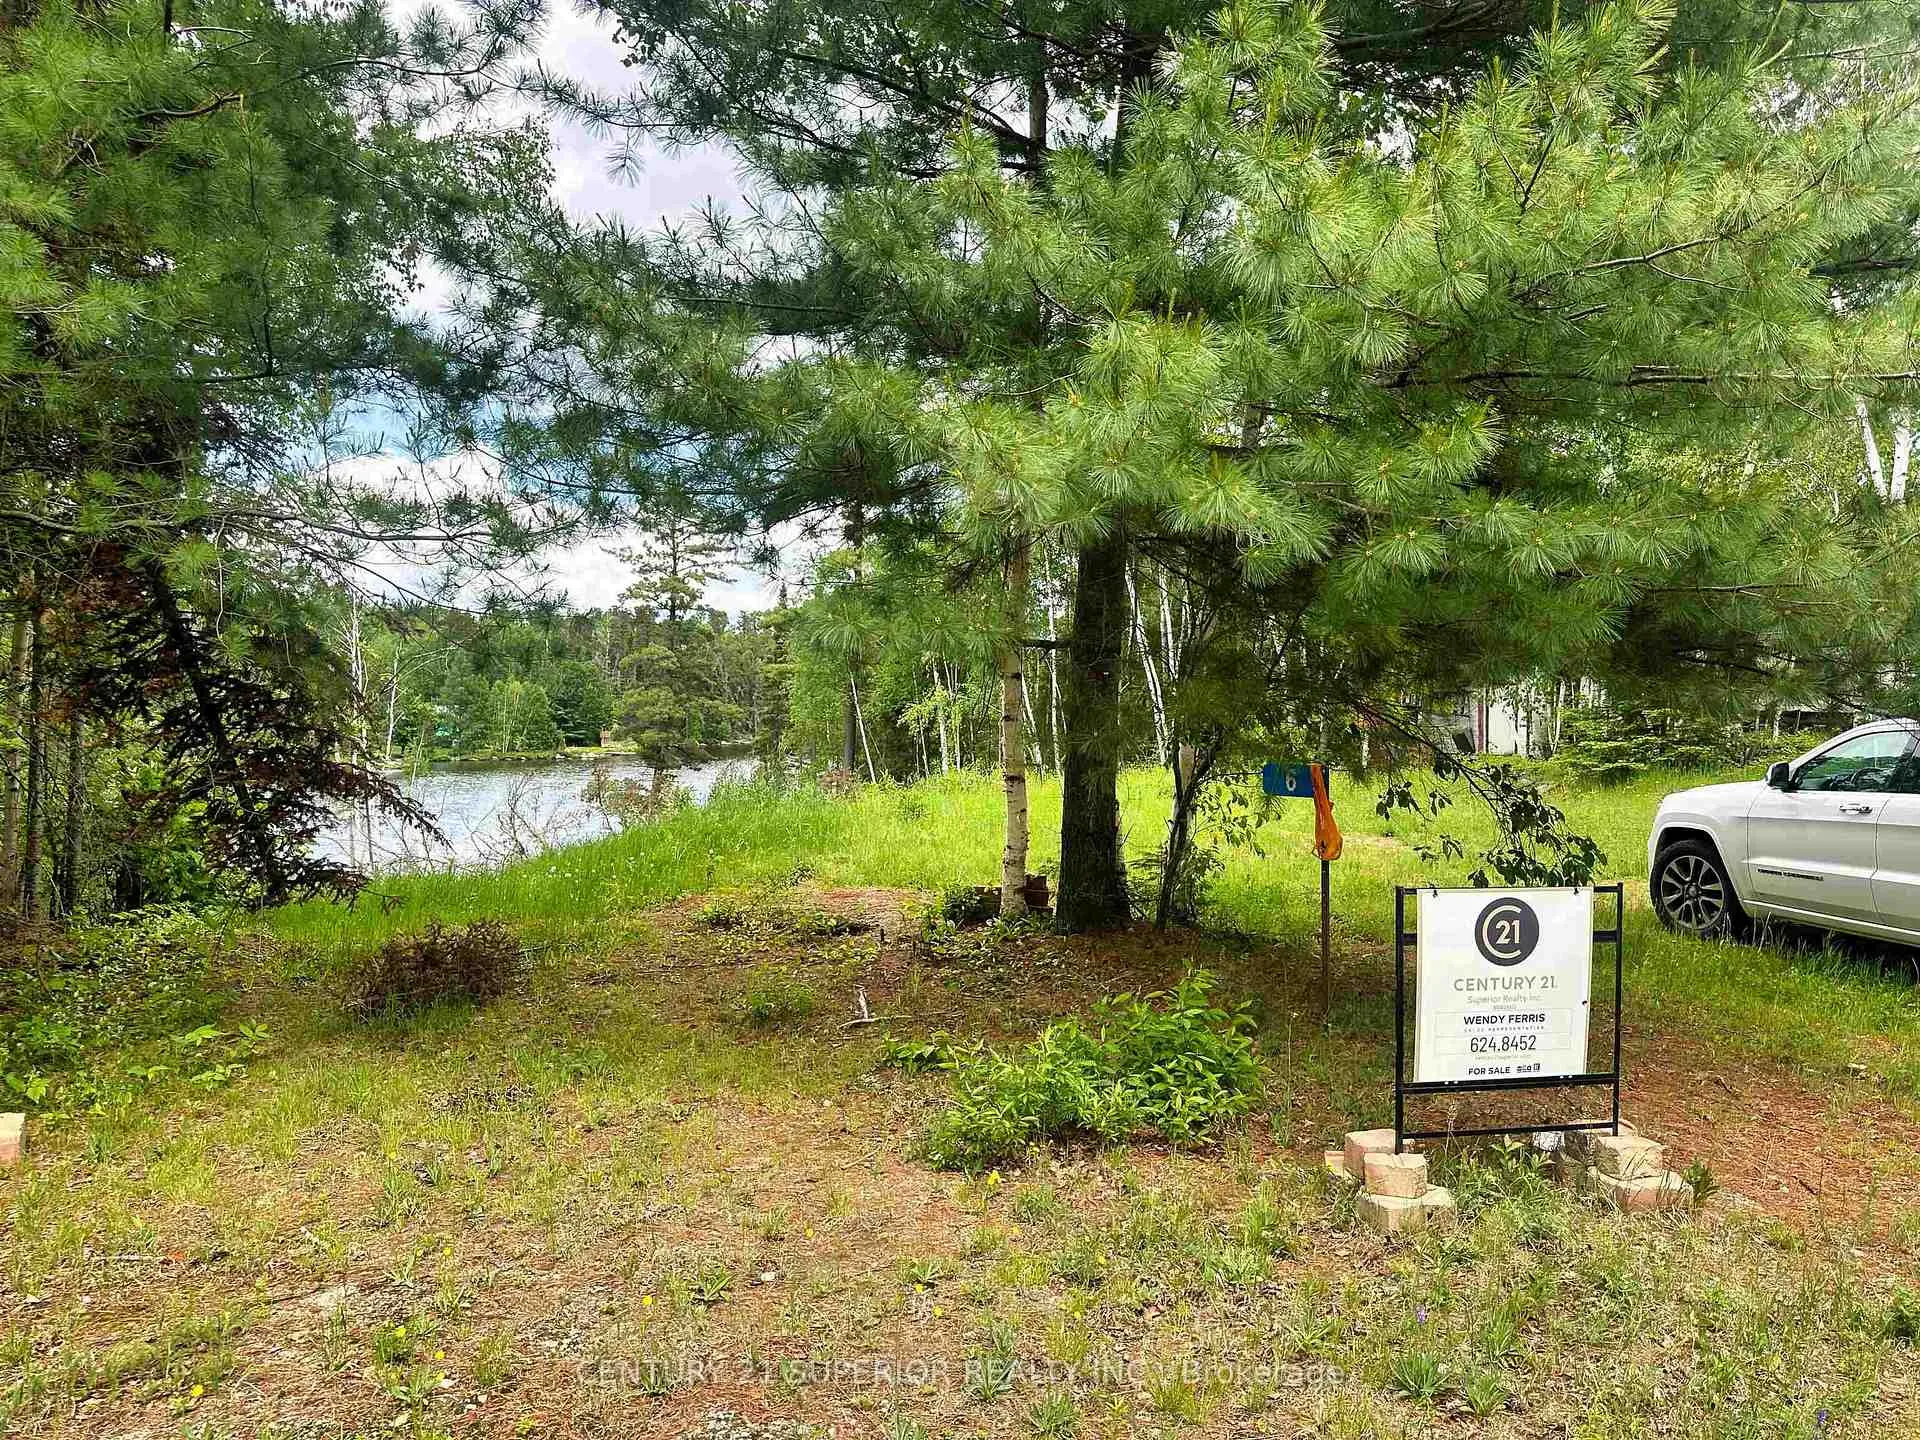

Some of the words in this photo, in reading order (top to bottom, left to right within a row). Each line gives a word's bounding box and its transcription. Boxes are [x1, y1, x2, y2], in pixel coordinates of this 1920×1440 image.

[1285, 767, 1297, 792] 6
[1495, 919, 1520, 944] 21
[1454, 976, 1536, 991] CENTURY
[1540, 976, 1555, 989] 21
[1464, 1015, 1505, 1025] WENDY
[1508, 1013, 1546, 1023] FERRIS
[1470, 1035, 1537, 1053] 624.8452
[1468, 1068, 1486, 1076] FOR
[1488, 1066, 1511, 1074] SALE
